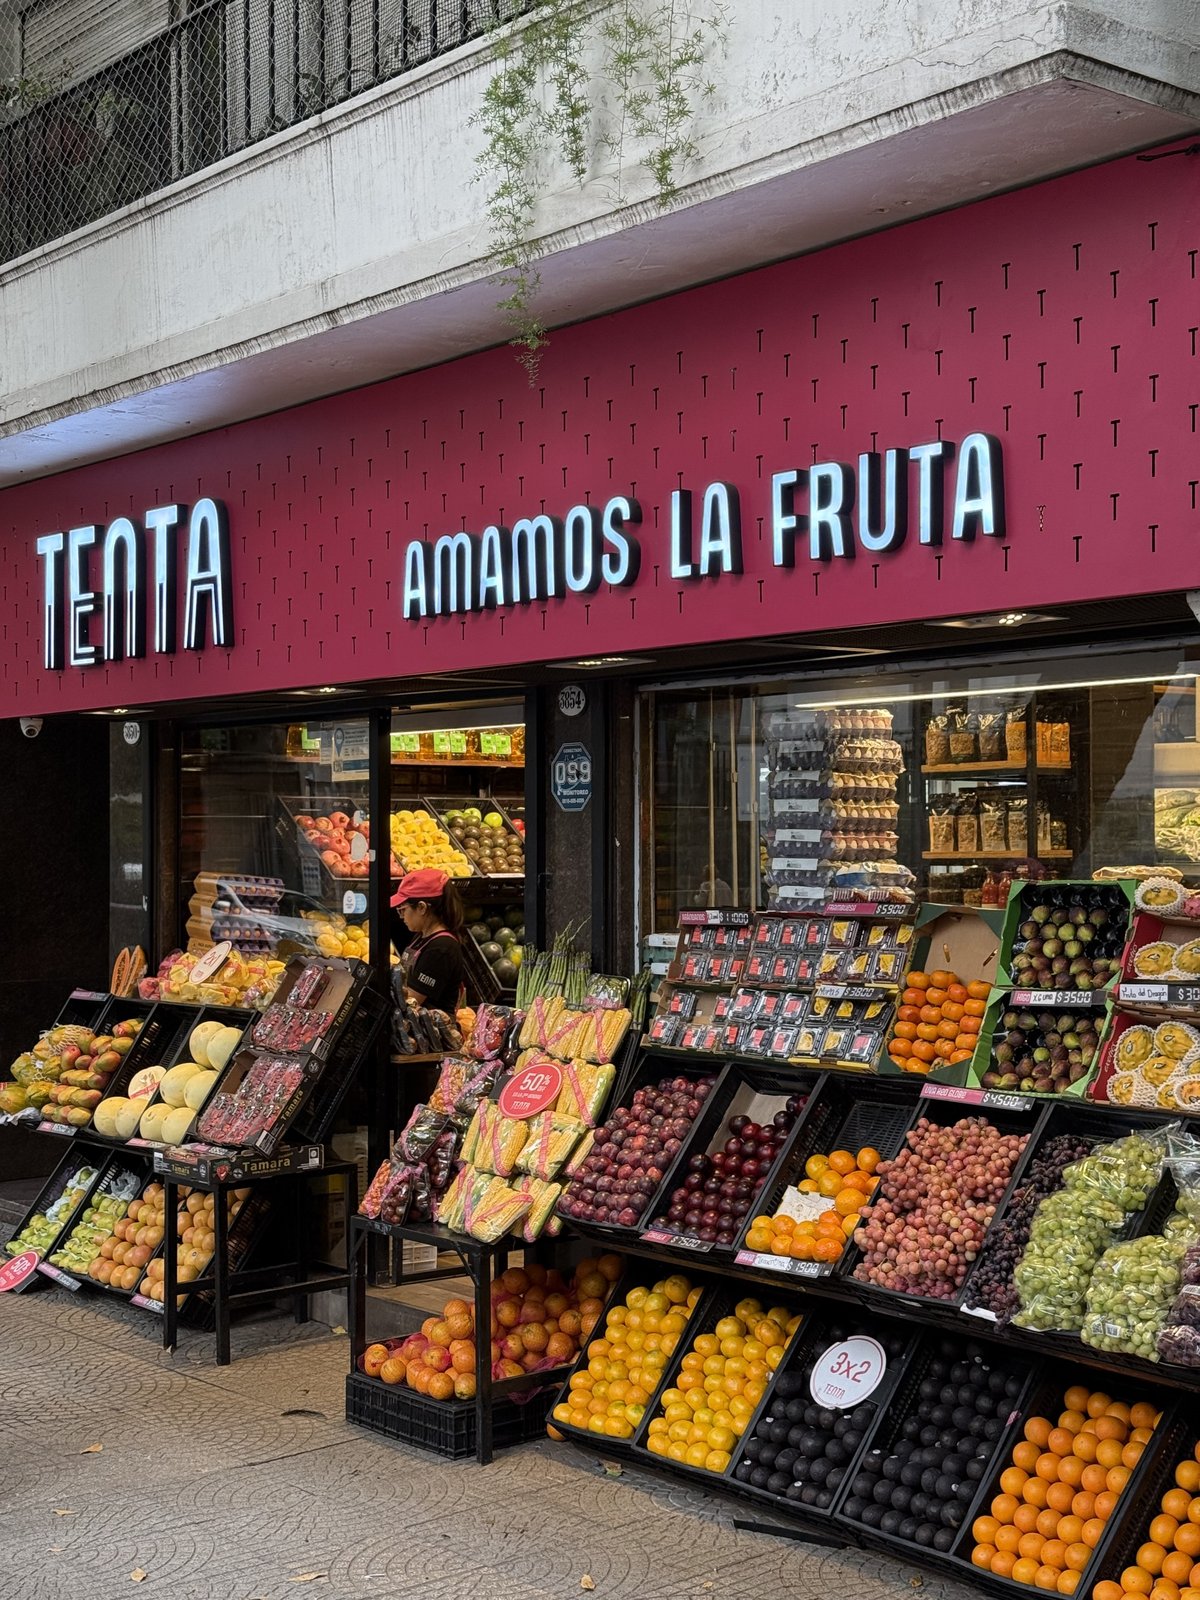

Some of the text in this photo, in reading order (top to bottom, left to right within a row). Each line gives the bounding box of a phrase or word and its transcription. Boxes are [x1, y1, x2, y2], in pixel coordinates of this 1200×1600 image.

[403, 432, 1000, 620] AMAMOS LA FRUTA
[37, 497, 227, 671] TENTA
[555, 760, 591, 785] 099
[876, 904, 906, 915] $5900
[418, 972, 436, 987] TENTA
[844, 987, 875, 998] $3800
[1057, 991, 1092, 1003] $3500
[334, 996, 355, 1027] Tamara
[520, 1072, 552, 1091] 50%
[281, 1089, 304, 1121] Tamara
[511, 1101, 531, 1111] TENTA
[983, 1093, 1019, 1107] $4500
[172, 1164, 190, 1175] Tamara
[242, 1157, 291, 1173] Tamara
[830, 1351, 872, 1383] 3x2
[823, 1383, 846, 1400] TENTA
